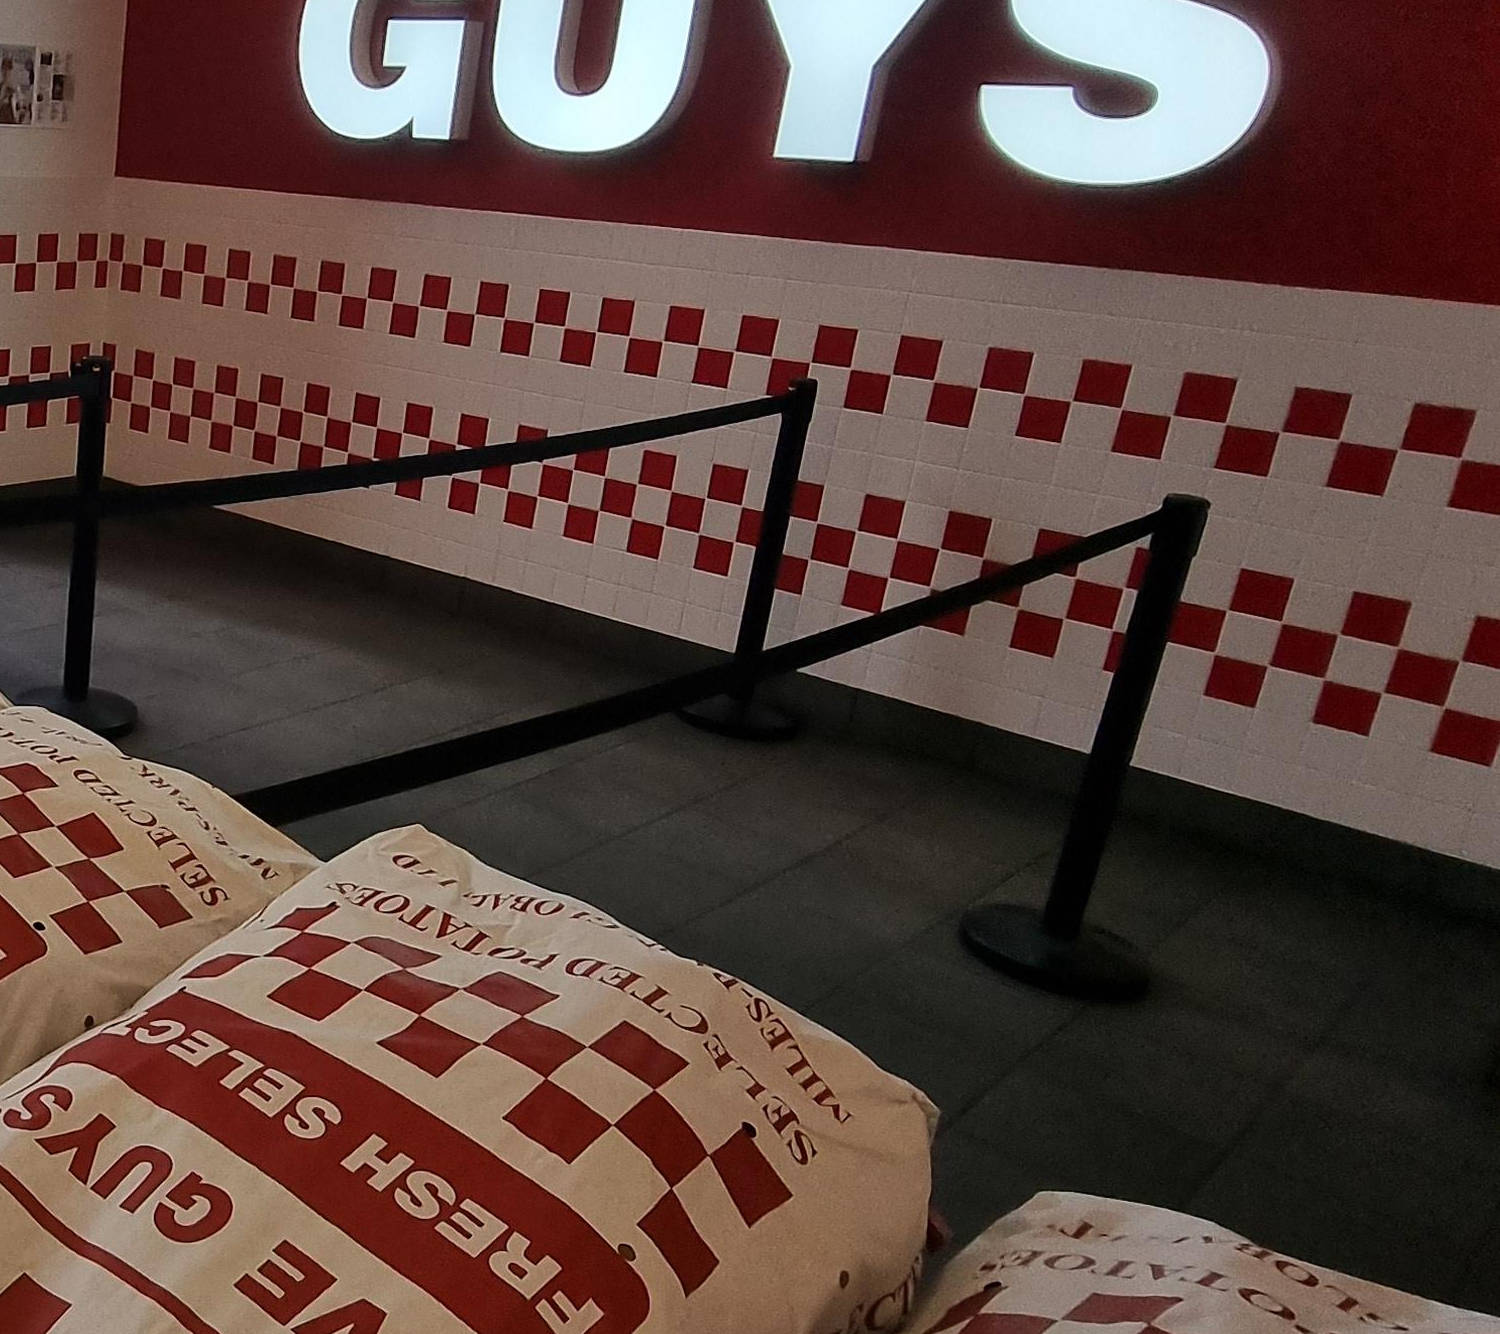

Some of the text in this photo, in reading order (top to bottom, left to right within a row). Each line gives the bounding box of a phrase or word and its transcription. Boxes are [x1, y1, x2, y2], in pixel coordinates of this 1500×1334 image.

[72, 768, 230, 908] SELECTED
[323, 880, 820, 1167] SELECTED POTATOES
[2, 1082, 236, 1244] GUYS
